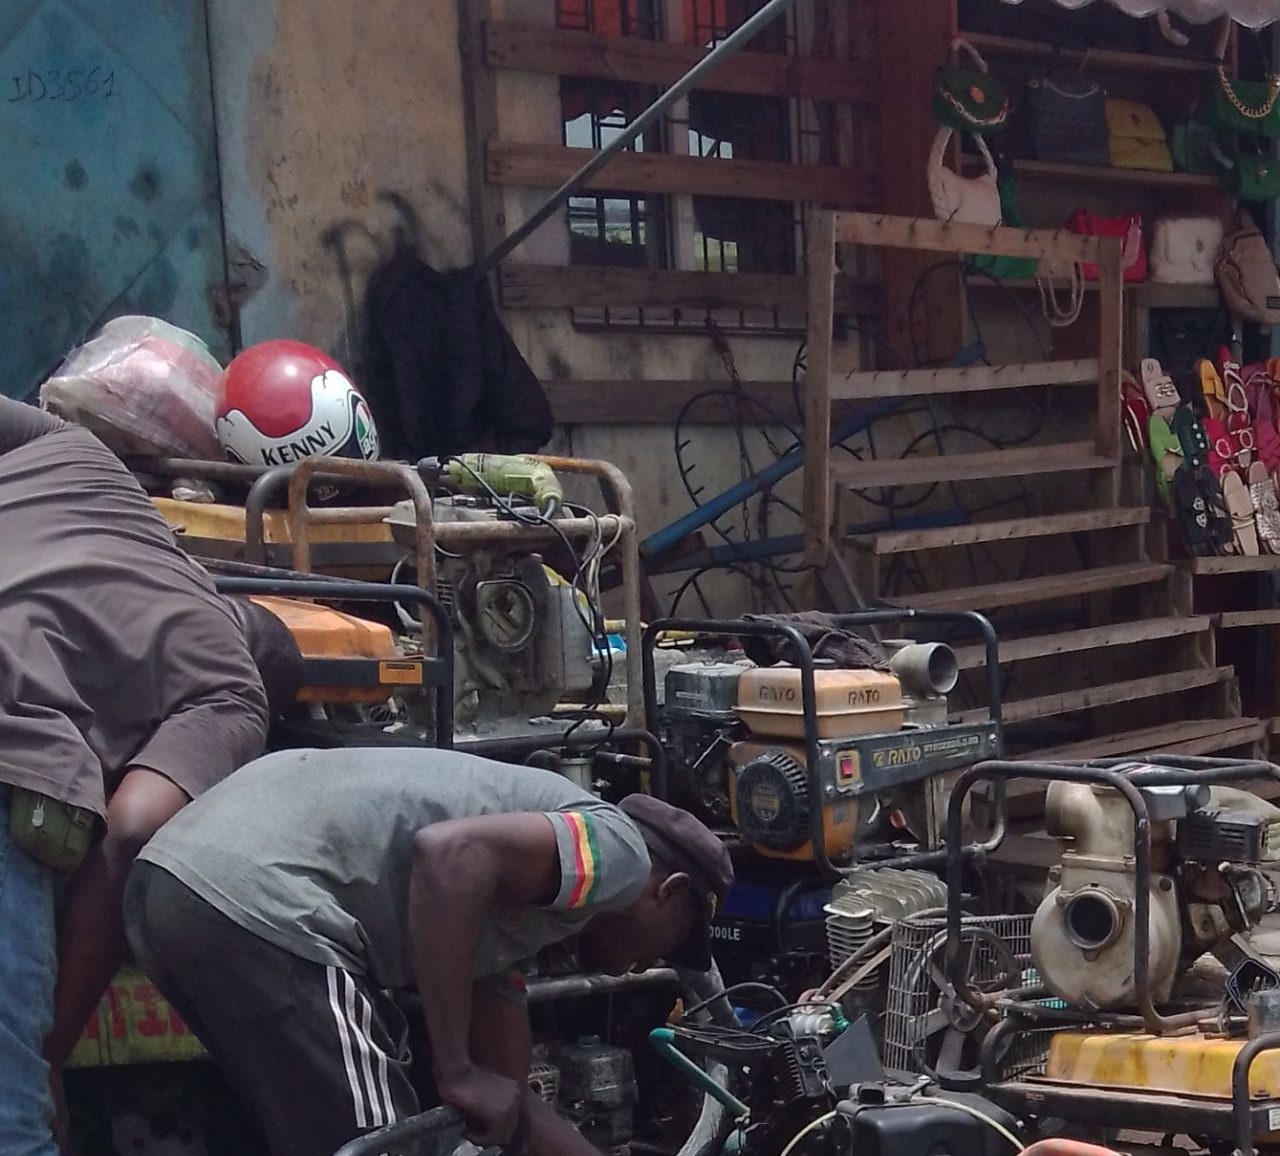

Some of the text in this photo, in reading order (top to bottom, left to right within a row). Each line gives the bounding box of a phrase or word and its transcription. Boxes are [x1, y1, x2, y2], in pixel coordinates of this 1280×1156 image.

[260, 420, 336, 467] KENNY
[847, 689, 881, 706] RATO
[888, 745, 922, 766] RATO
